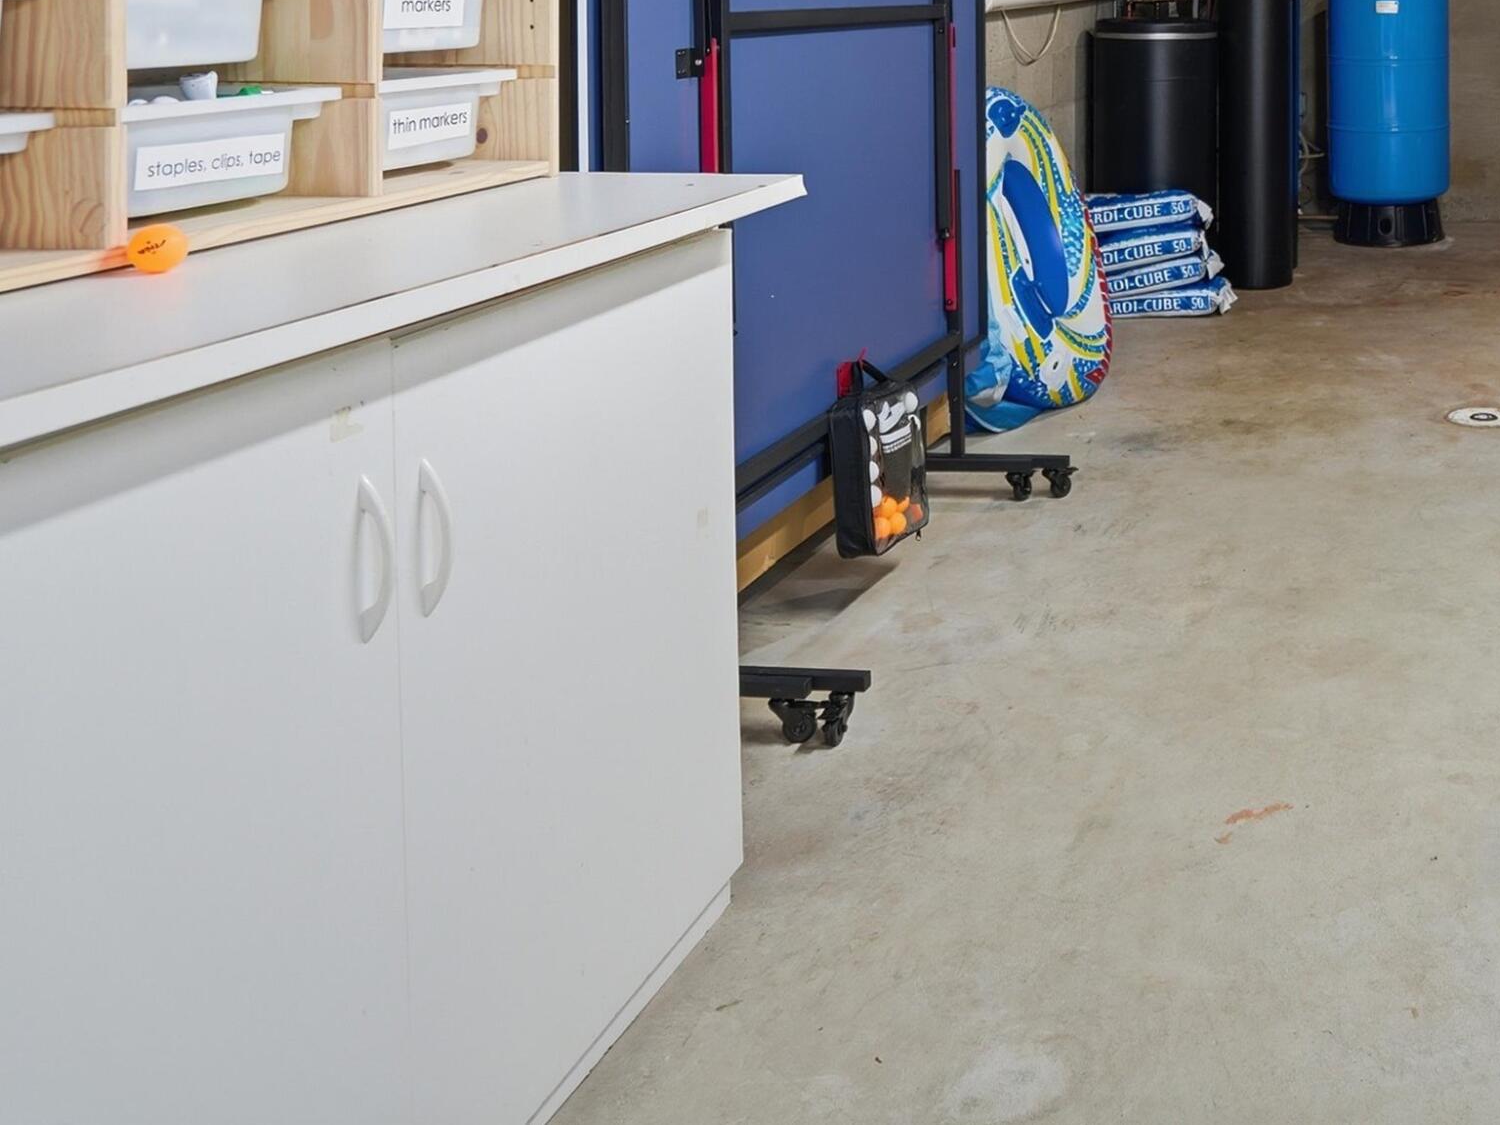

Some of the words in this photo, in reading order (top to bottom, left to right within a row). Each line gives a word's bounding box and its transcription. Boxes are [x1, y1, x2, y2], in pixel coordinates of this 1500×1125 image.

[393, 117, 416, 135] thin
[419, 111, 467, 131] markers
[147, 158, 206, 178] staples,
[211, 153, 244, 171] clips,
[249, 149, 281, 166] tape
[1094, 203, 1162, 225] RDI-CUBE
[1103, 242, 1163, 266] DI-CUBE
[1109, 269, 1172, 293] DI-CUBE
[1110, 298, 1181, 314] RDI-CUBE
